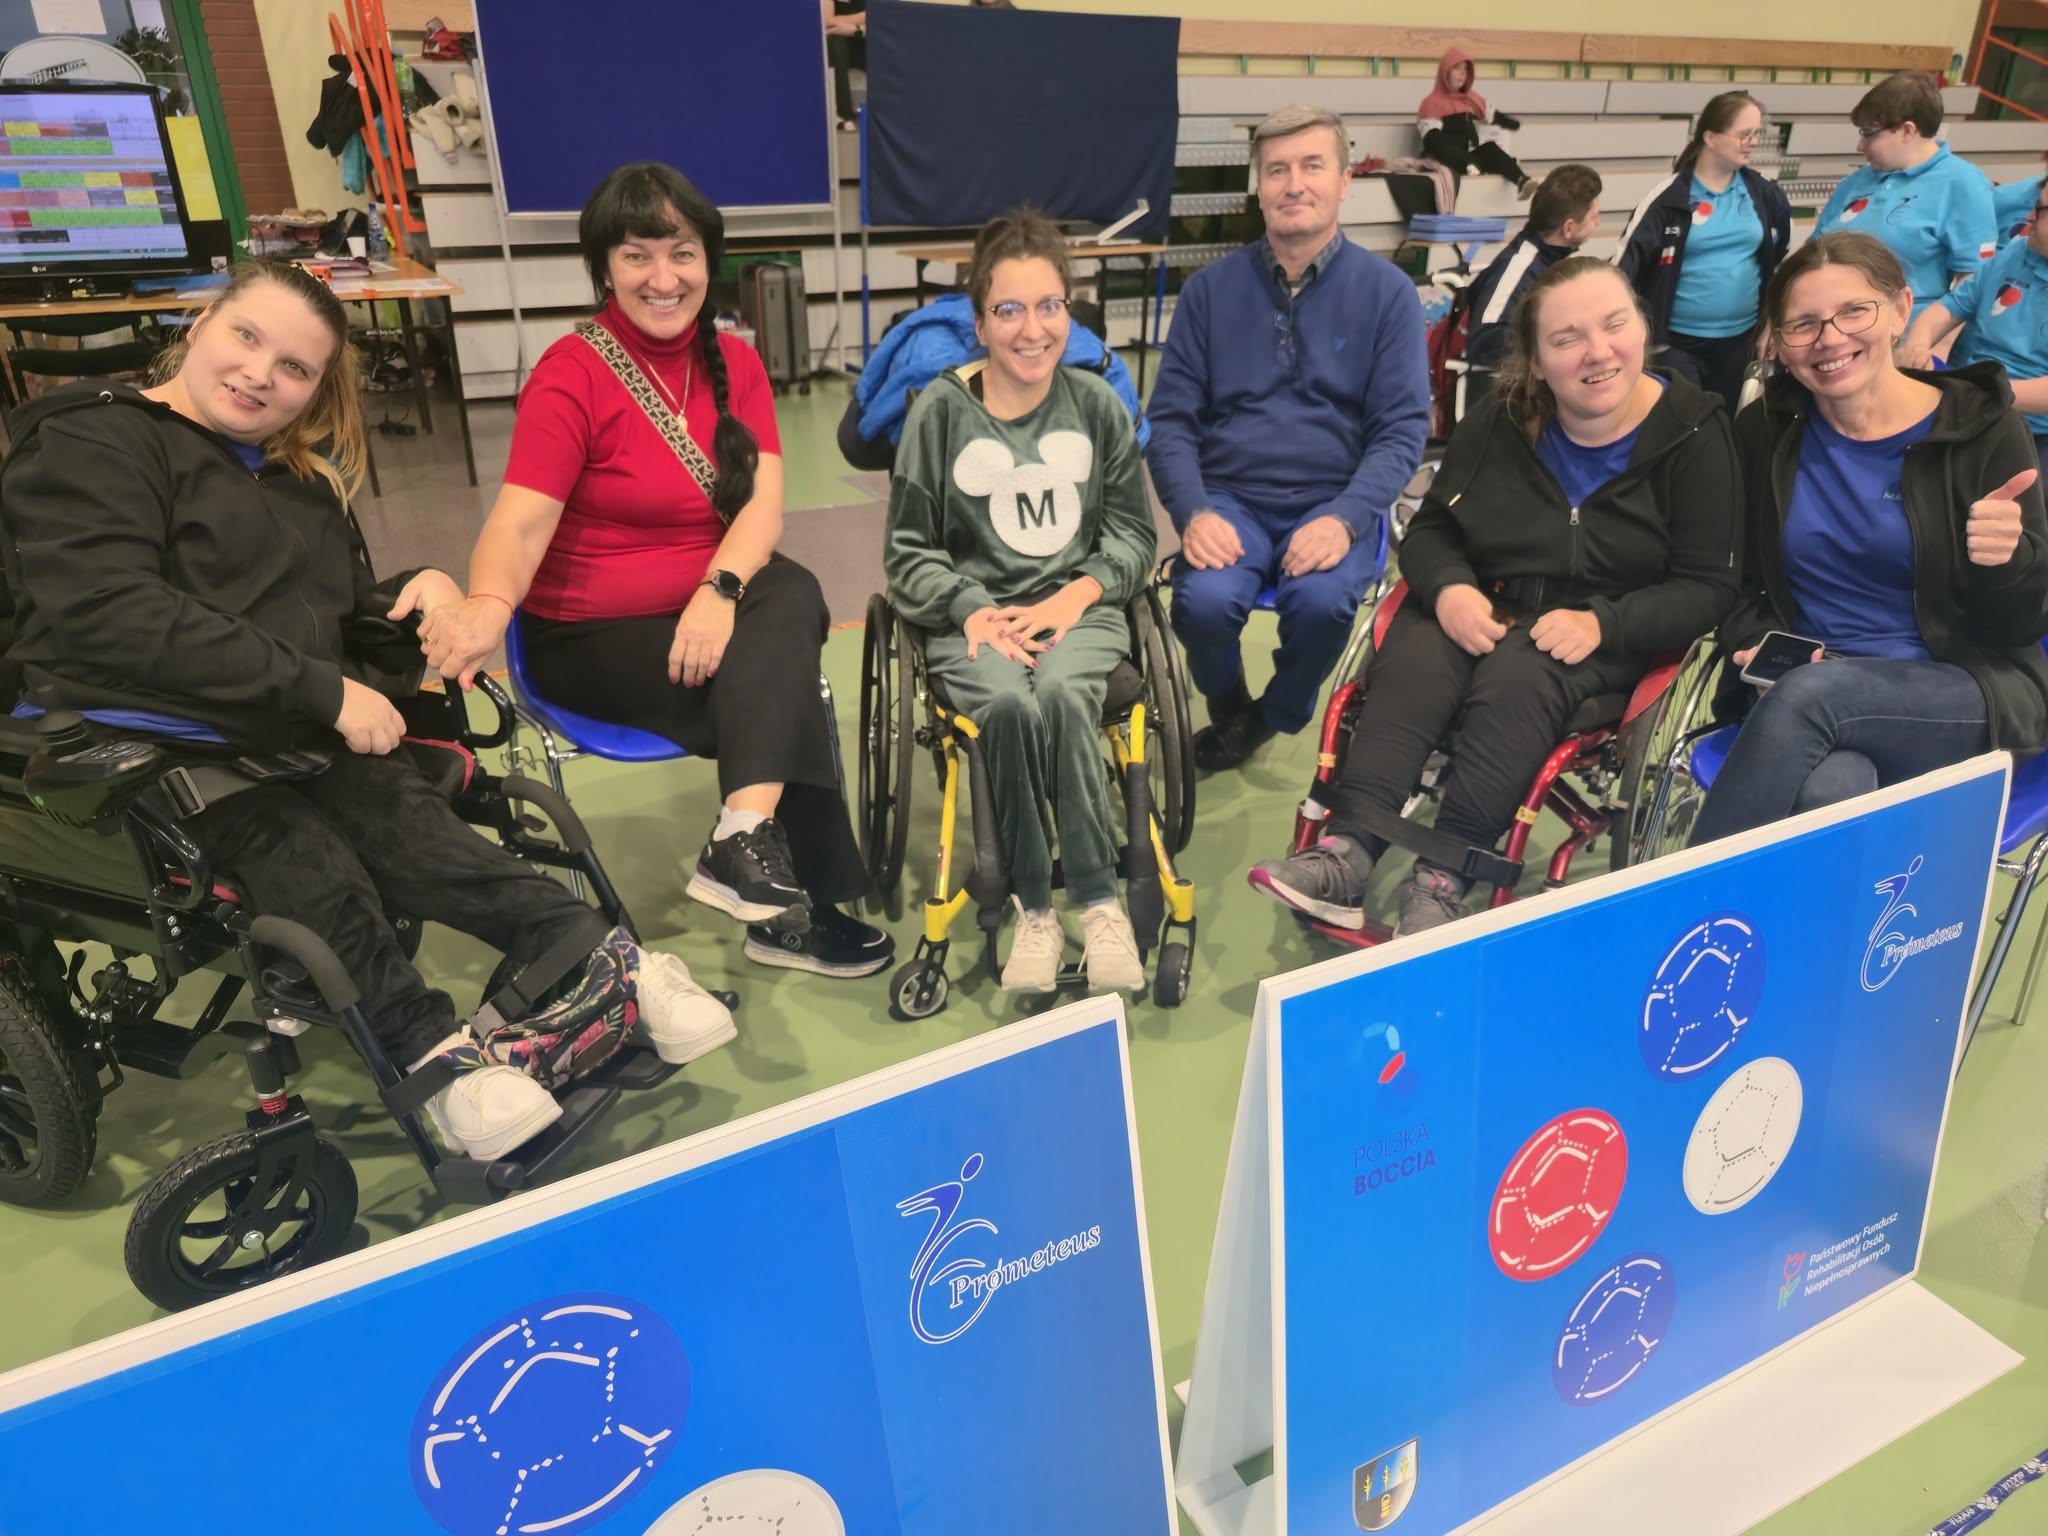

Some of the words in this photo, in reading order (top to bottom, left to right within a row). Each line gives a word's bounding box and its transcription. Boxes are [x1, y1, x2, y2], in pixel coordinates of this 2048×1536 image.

[1016, 488, 1057, 530] M
[1880, 921, 1964, 968] Prometeus
[1354, 1122, 1430, 1169] POLSKA
[1354, 1147, 1437, 1198] BOCCIA
[1806, 1244, 1861, 1281] Rehabilitacji
[1862, 1232, 1885, 1252] Osób
[1808, 1231, 1862, 1266] Państwowy
[1862, 1212, 1899, 1238] Fundusz
[949, 1225, 1101, 1309] Prometeus
[1804, 1243, 1891, 1297] Niepełnosprawnych
[1949, 1507, 1976, 1526] BOCCIA
